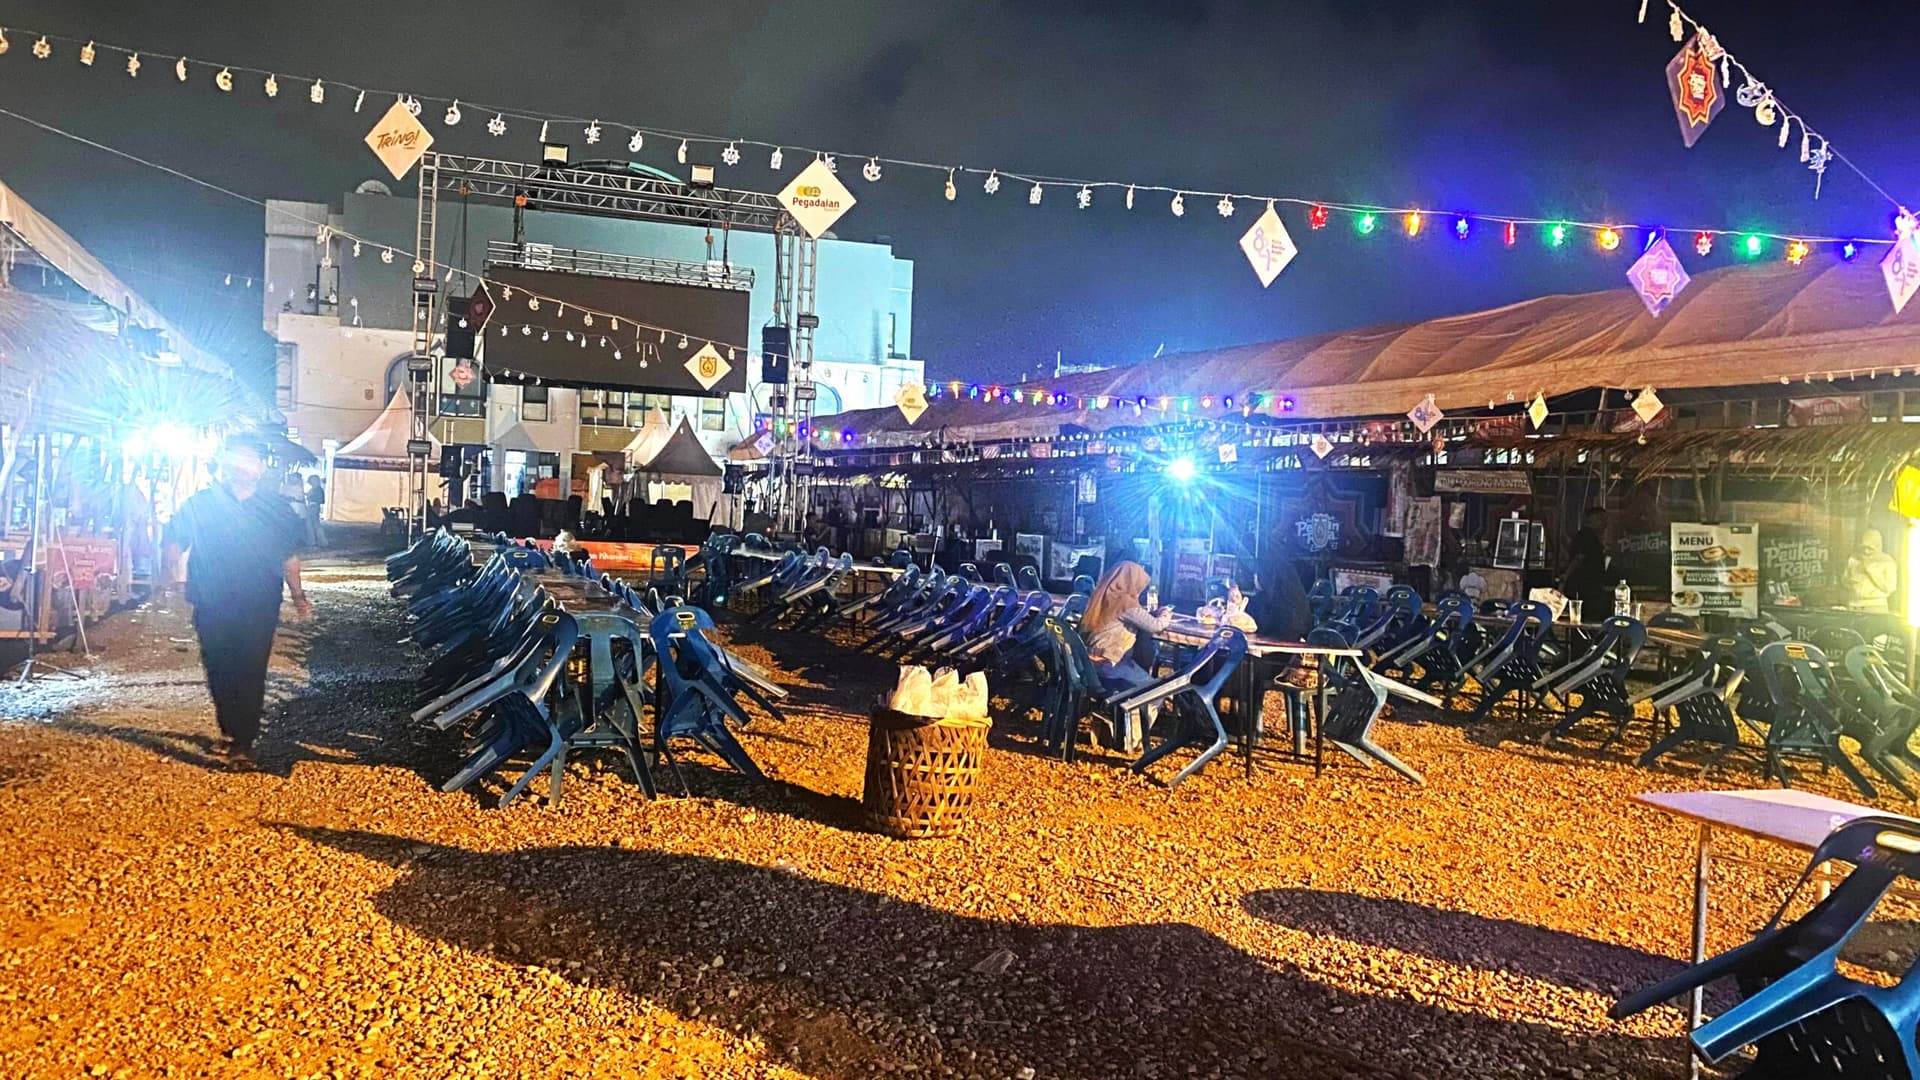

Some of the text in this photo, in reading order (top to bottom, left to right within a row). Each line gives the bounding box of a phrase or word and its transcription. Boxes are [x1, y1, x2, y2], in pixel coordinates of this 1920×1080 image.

[792, 197, 840, 208] Pegadaian
[1679, 536, 1714, 546] MENU
[1763, 543, 1829, 568] Peukan
[1774, 560, 1823, 578] Raya
